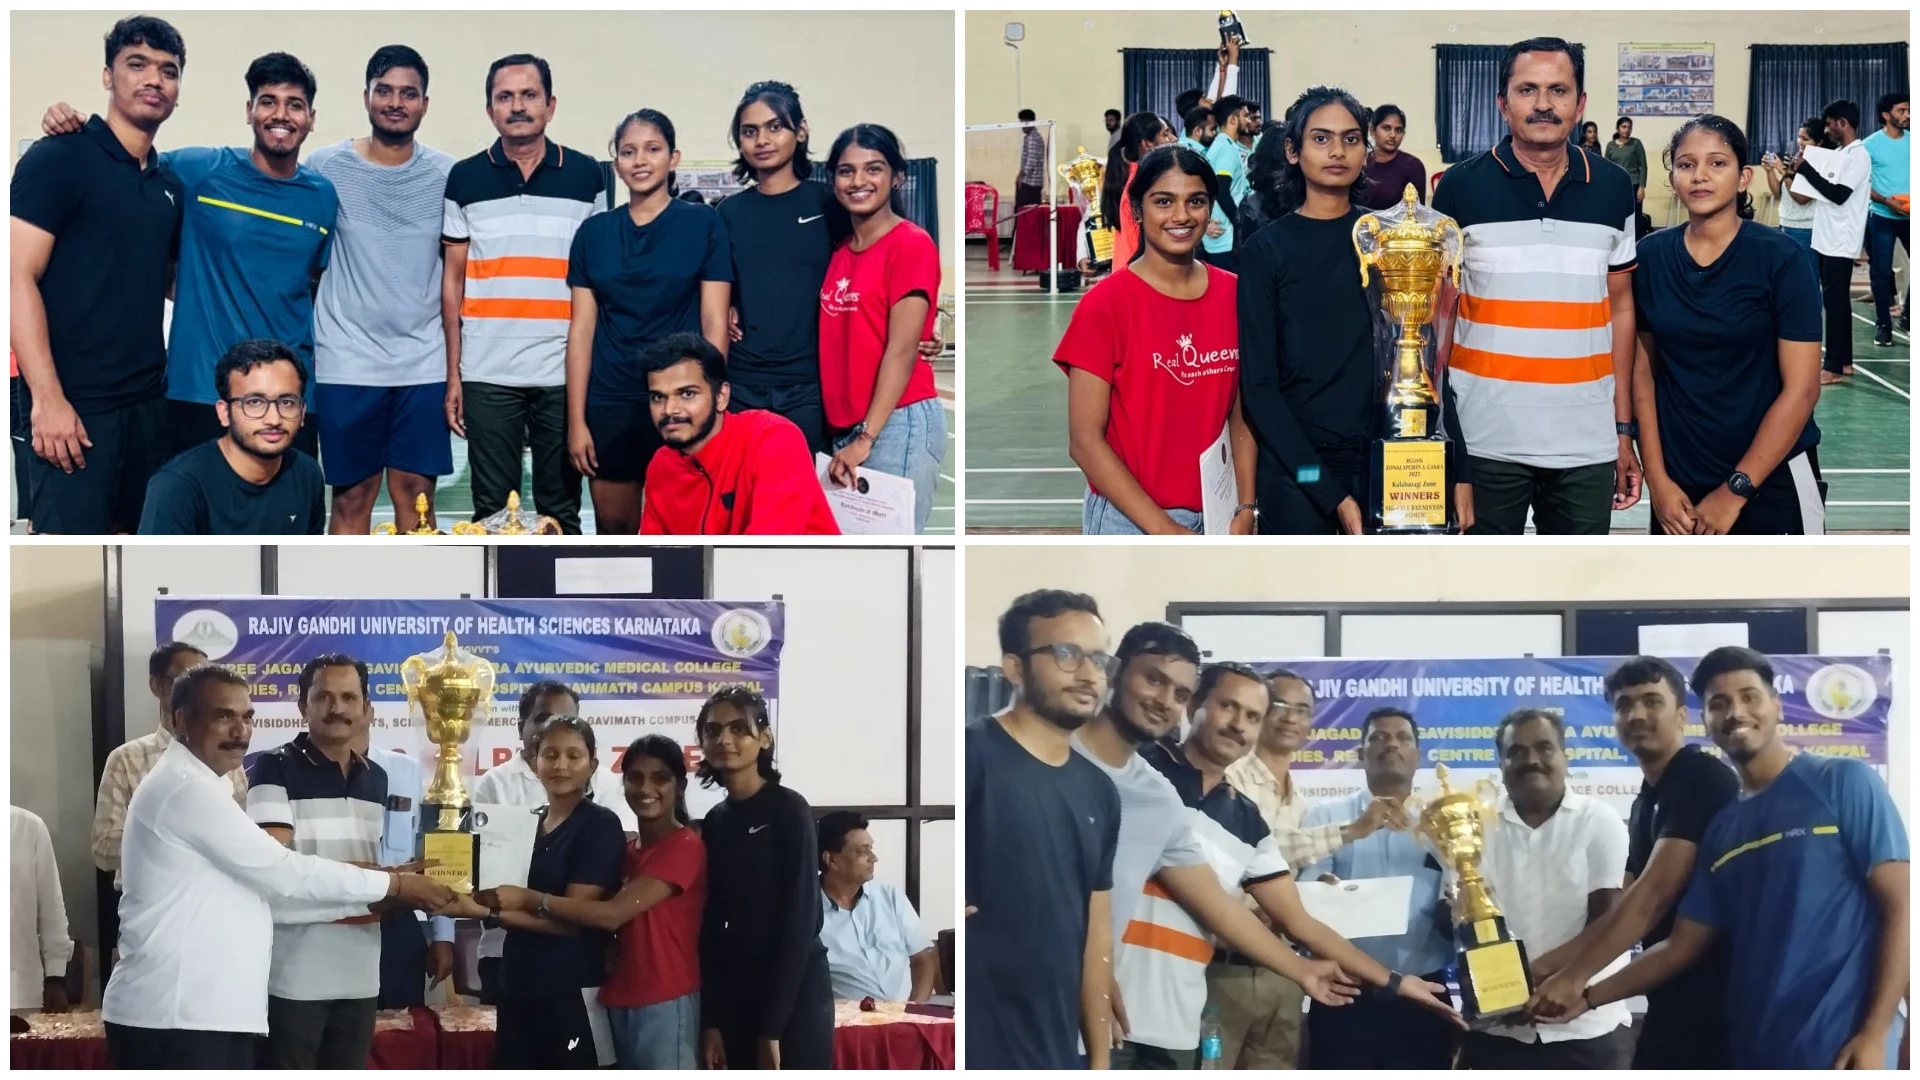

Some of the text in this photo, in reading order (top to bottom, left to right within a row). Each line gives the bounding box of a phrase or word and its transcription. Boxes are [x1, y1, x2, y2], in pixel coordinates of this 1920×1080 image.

[1152, 353, 1181, 369] Real
[1202, 367, 1223, 376] others
[1389, 491, 1440, 501] WINNERS
[249, 616, 701, 635] RAJIV GANDHI UNIVERSITY OF HEALTH SCIENCES KARNATAKA
[261, 663, 306, 675] JAGA
[514, 662, 600, 674] AYURVEDIC
[604, 661, 670, 673] MEDICAL
[674, 661, 741, 673] COLLEGE
[566, 682, 637, 693] AVIMATH
[642, 681, 704, 693] CAMPUS
[1313, 675, 1605, 698] JIV GANDHI UNIVERSITY OF HEALTH
[252, 718, 308, 728] VISIDDHE
[587, 716, 645, 726] GAVIMATH
[649, 715, 697, 725] COMPUS
[1306, 728, 1363, 740] JAGAD
[1417, 726, 1497, 739] GAVISIDD
[1776, 723, 1843, 736] OLLEGE
[1427, 749, 1495, 761] CENTRE
[1564, 747, 1628, 762] SPITAL,
[1597, 785, 1639, 795] COLLE
[429, 869, 468, 877] WINNERS
